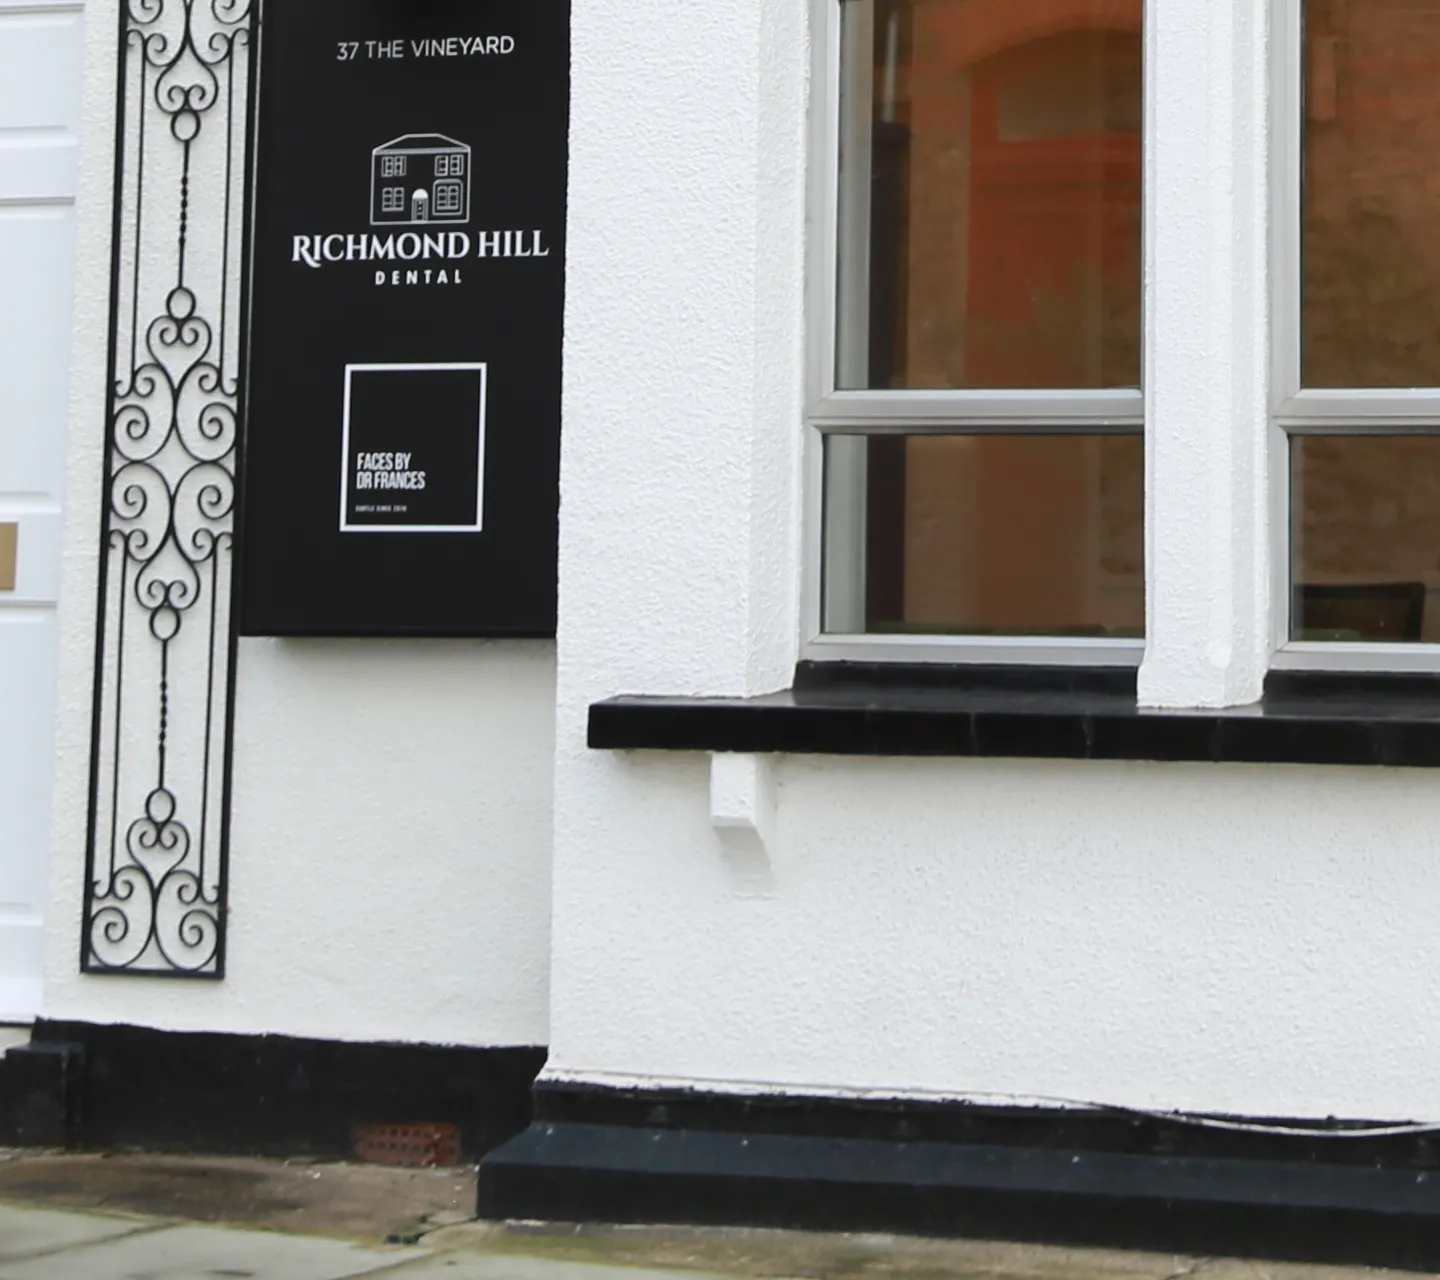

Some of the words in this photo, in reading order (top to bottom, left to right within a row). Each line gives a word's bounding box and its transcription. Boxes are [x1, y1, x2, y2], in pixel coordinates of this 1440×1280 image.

[336, 42, 360, 61] 37
[365, 40, 404, 58] THE
[411, 35, 515, 57] VINEYARD
[292, 231, 470, 268] RICHMOND
[477, 229, 550, 258] HILL
[375, 269, 462, 285] DENTAL
[357, 452, 394, 470] FACES
[395, 452, 411, 470] BY
[356, 471, 372, 489] DR
[374, 471, 426, 489] FRANCES
